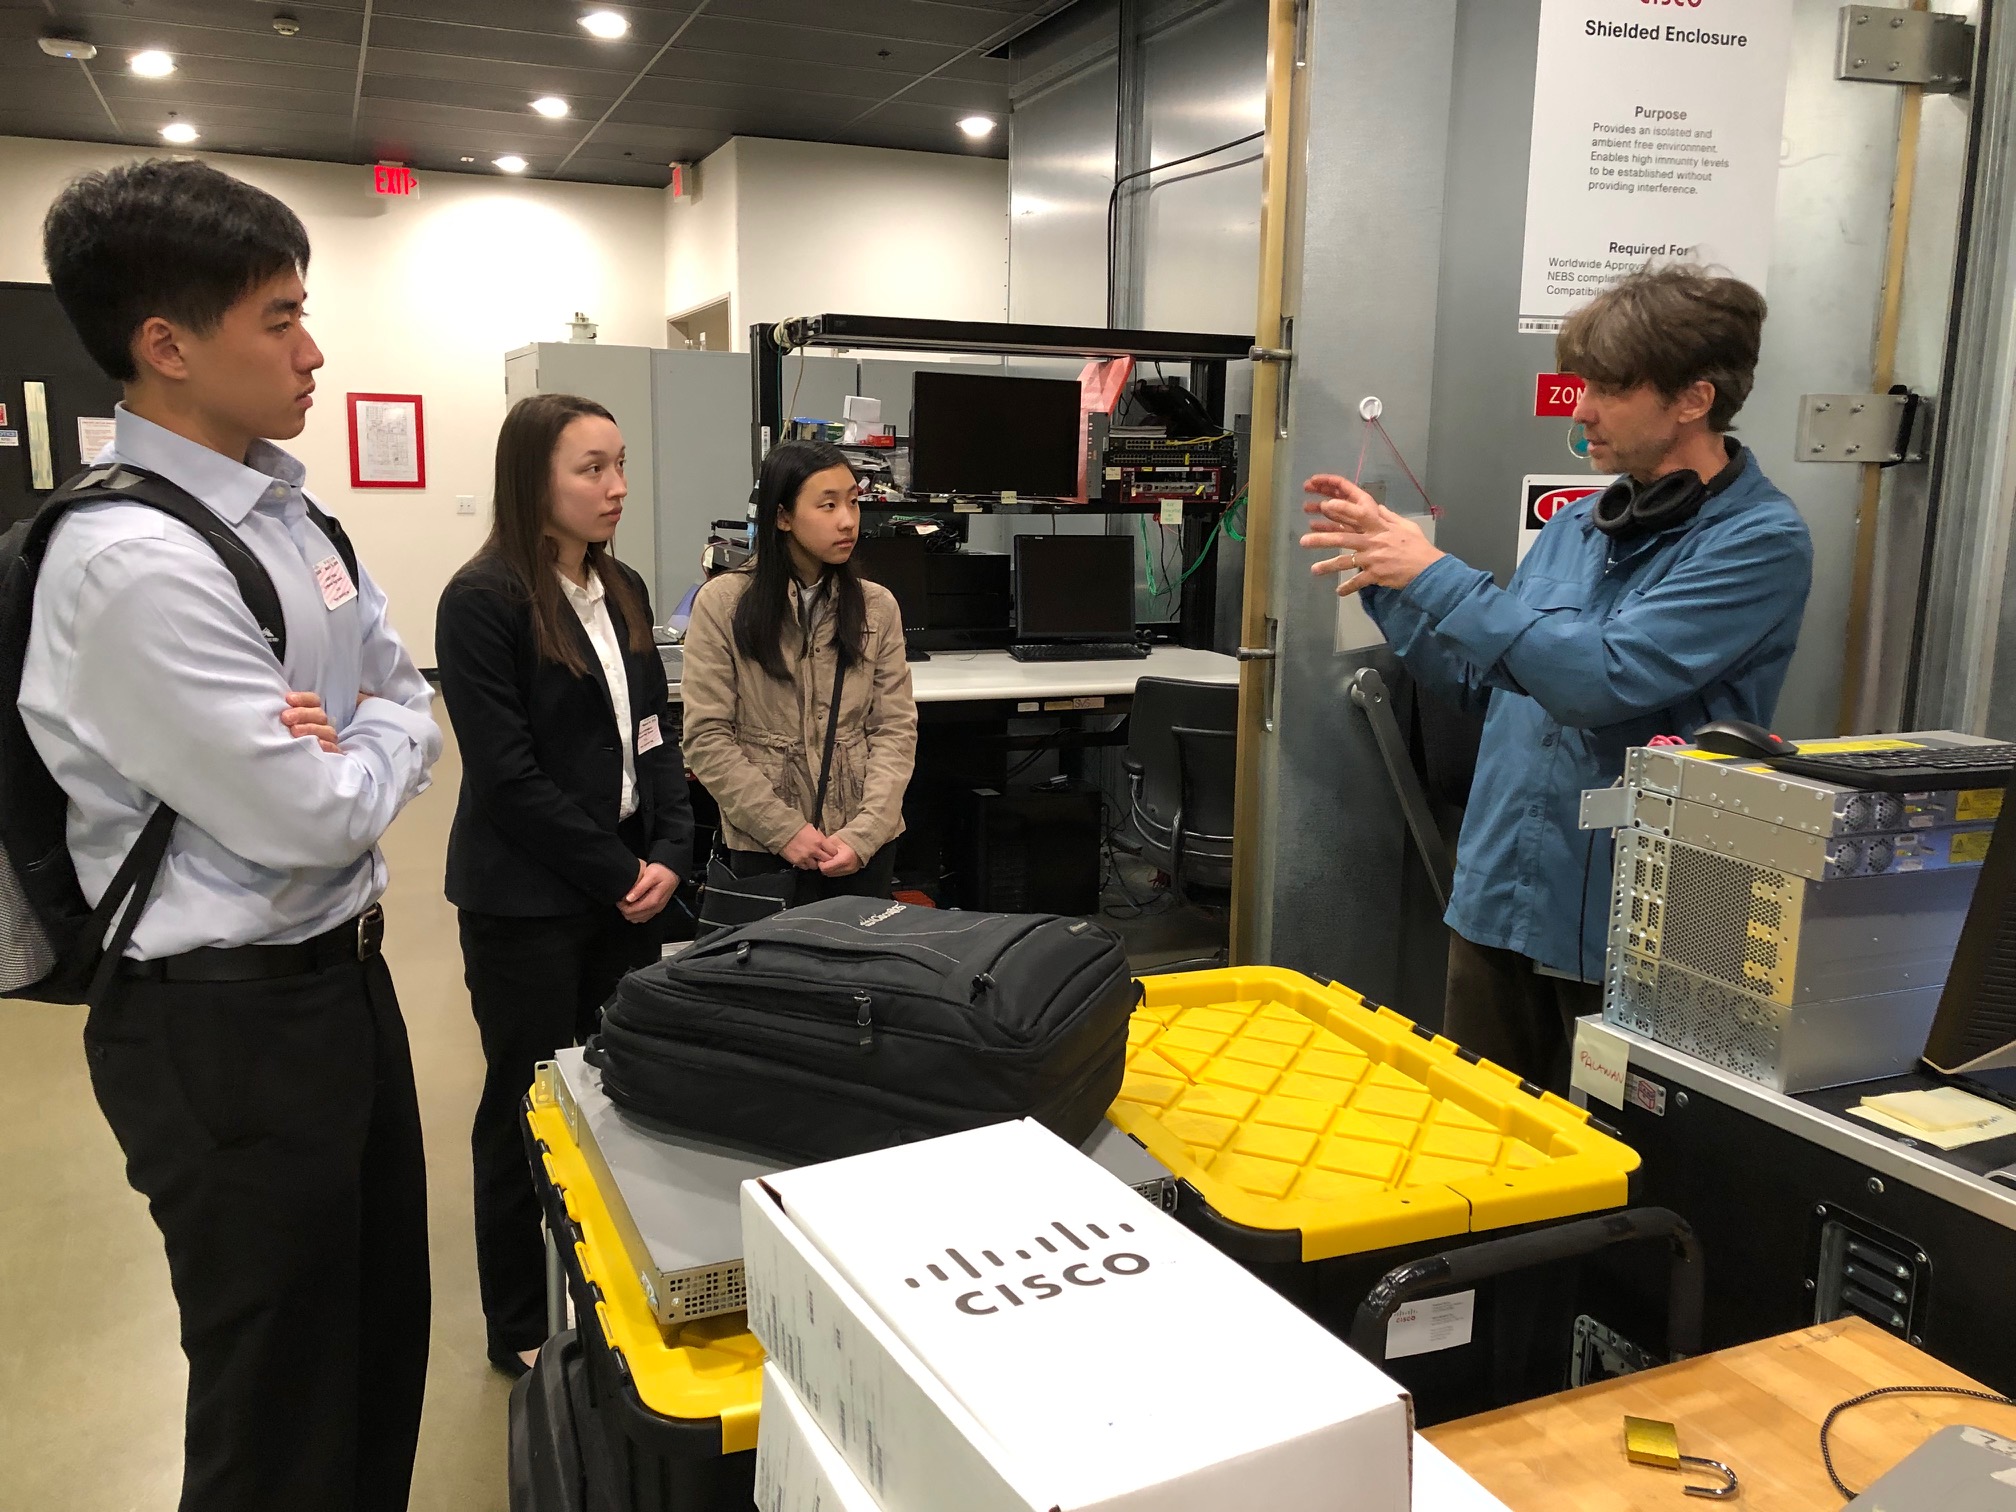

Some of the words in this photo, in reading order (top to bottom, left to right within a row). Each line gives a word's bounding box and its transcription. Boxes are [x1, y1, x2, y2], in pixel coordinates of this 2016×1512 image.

[1585, 19, 1660, 40] Shielded
[1665, 25, 1748, 47] Enclosure
[1634, 105, 1688, 122] Purpose
[1592, 122, 1636, 135] Provides
[1638, 127, 1650, 135] an
[1653, 126, 1692, 138] isolated
[1694, 129, 1712, 139] and
[1591, 137, 1632, 149] ambient
[1634, 138, 1654, 150] free
[1590, 151, 1629, 162] Enables
[1631, 153, 1652, 166] high
[1655, 156, 1699, 168] immunity
[1701, 157, 1730, 168] levels
[374, 165, 410, 195] EXIT
[1589, 166, 1599, 176] to
[1602, 166, 1615, 176] be
[1617, 168, 1674, 179] established
[1676, 171, 1712, 181] without
[1588, 180, 1635, 194] providing
[1637, 183, 1698, 195] interference.
[1609, 241, 1665, 256] Required
[1669, 244, 1688, 256] For
[1548, 257, 1602, 269] Worldwide
[1547, 271, 1575, 282] NEBS
[1580, 1050, 1625, 1084] PALAWAN
[955, 1253, 1150, 1315] CISCO
